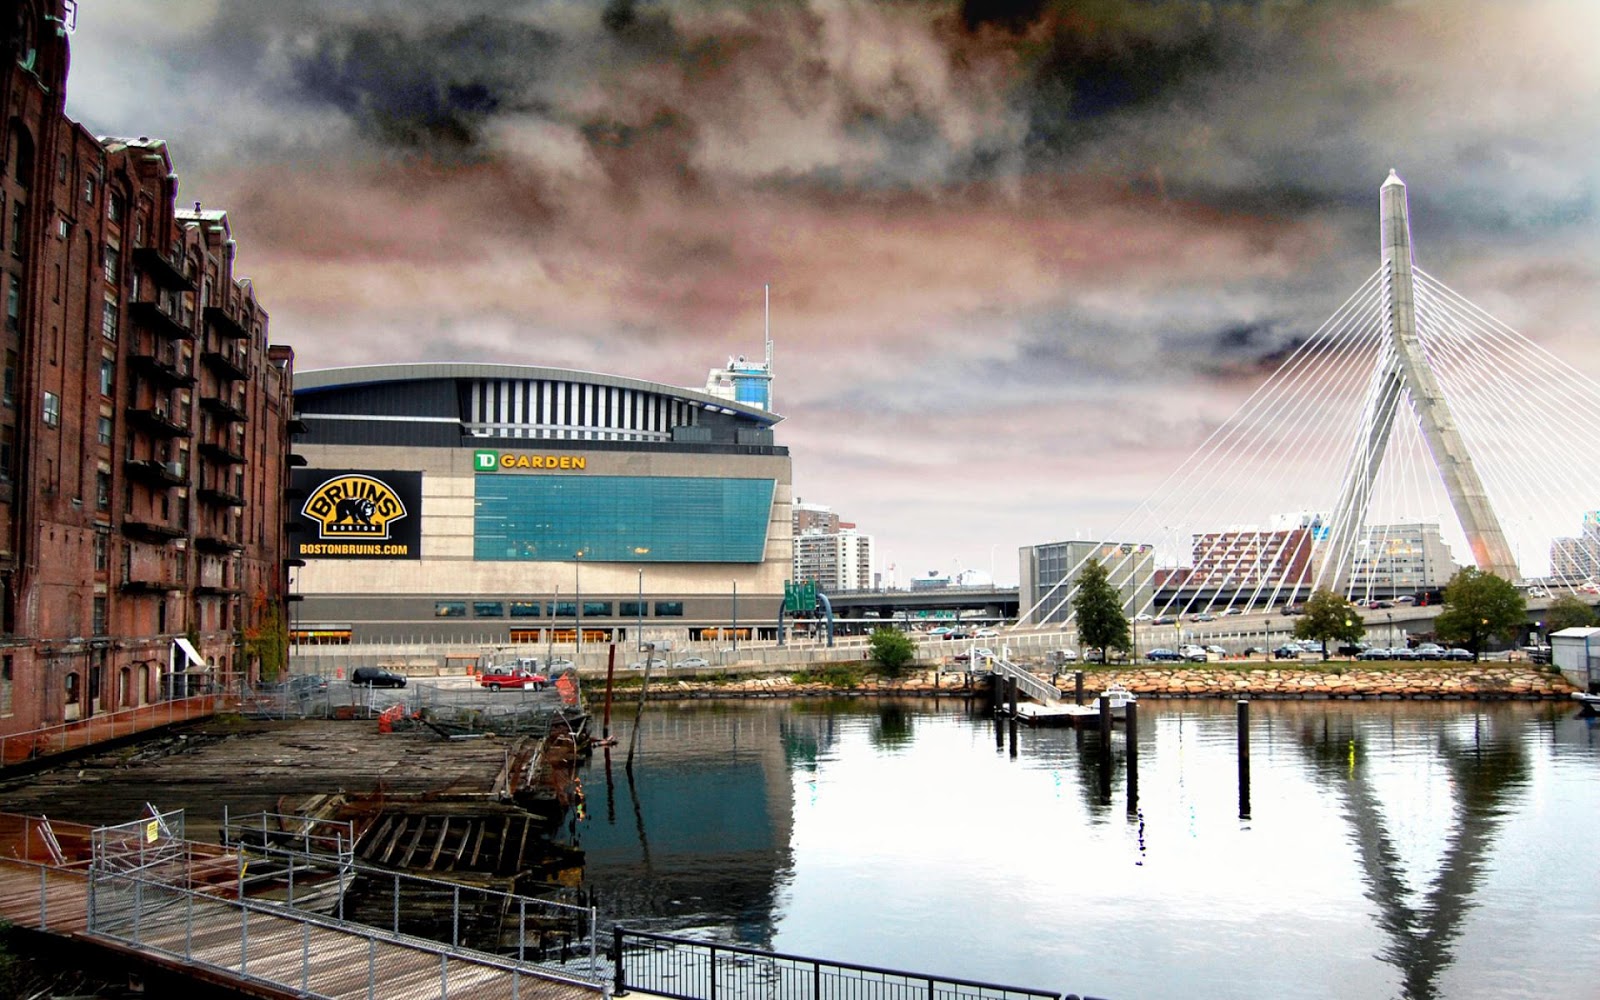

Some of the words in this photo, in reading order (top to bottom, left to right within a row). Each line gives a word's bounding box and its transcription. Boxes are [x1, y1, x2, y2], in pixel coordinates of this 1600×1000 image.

[476, 454, 496, 467] TD
[500, 454, 586, 469] GARDEN
[310, 481, 397, 517] BRUINS
[299, 544, 408, 555] BOSTONBRUINS.COM
